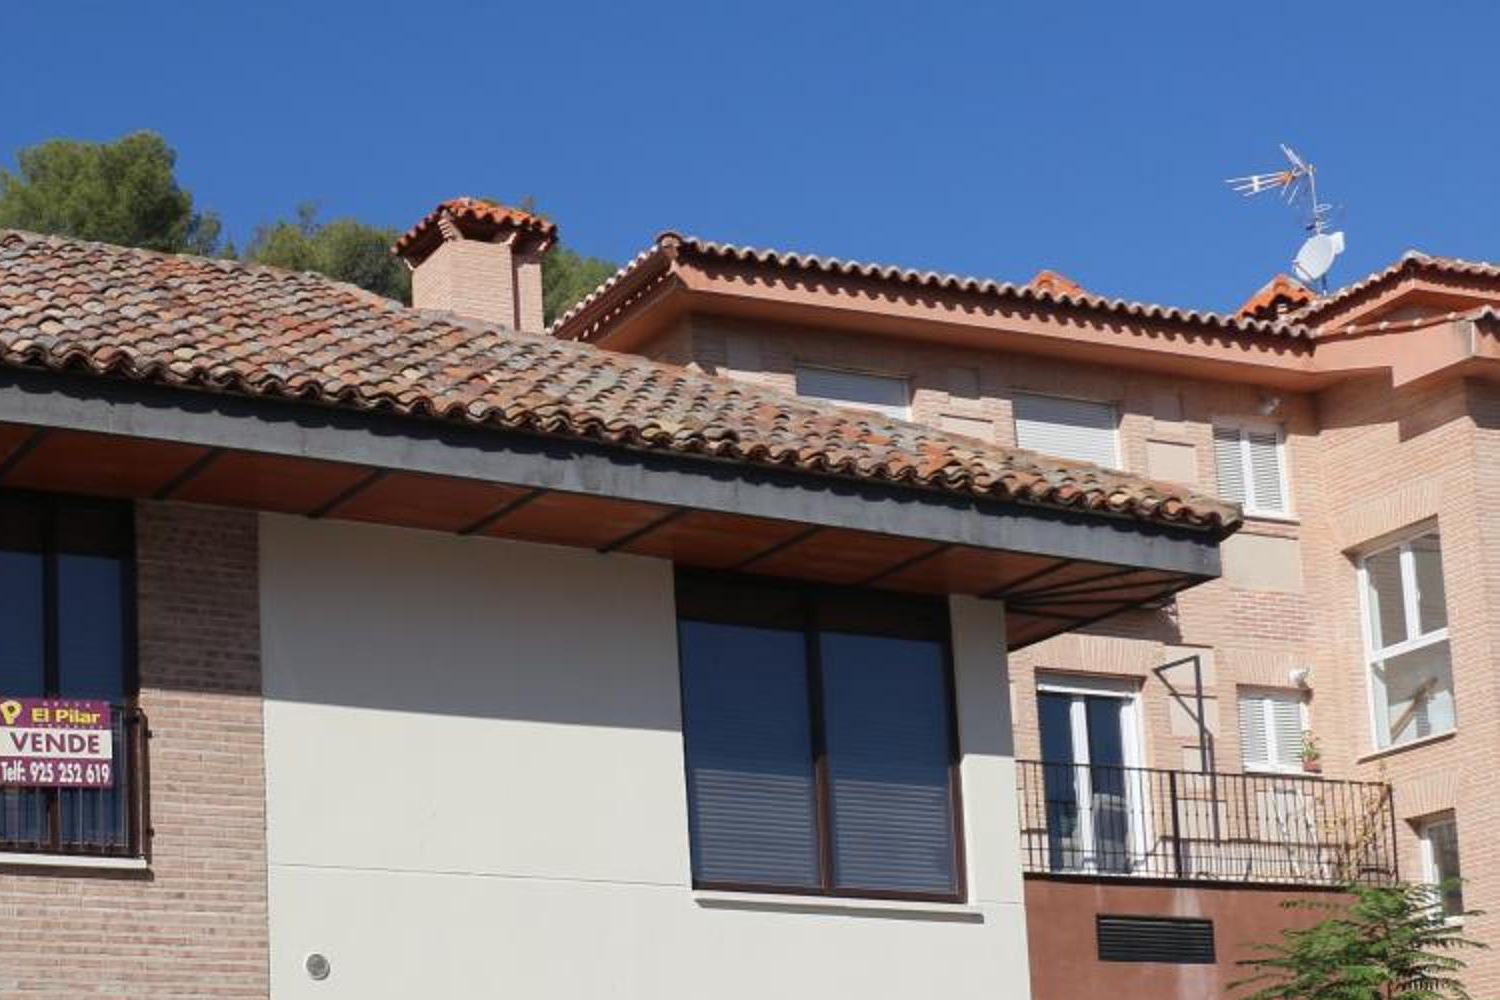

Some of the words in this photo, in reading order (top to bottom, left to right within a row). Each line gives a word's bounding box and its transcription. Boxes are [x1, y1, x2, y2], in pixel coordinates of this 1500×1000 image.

[31, 707, 49, 722] El
[55, 708, 101, 724] Pilar
[9, 732, 100, 753] VENDE
[30, 761, 54, 783] 925
[58, 763, 82, 783] 252
[86, 763, 110, 784] 619
